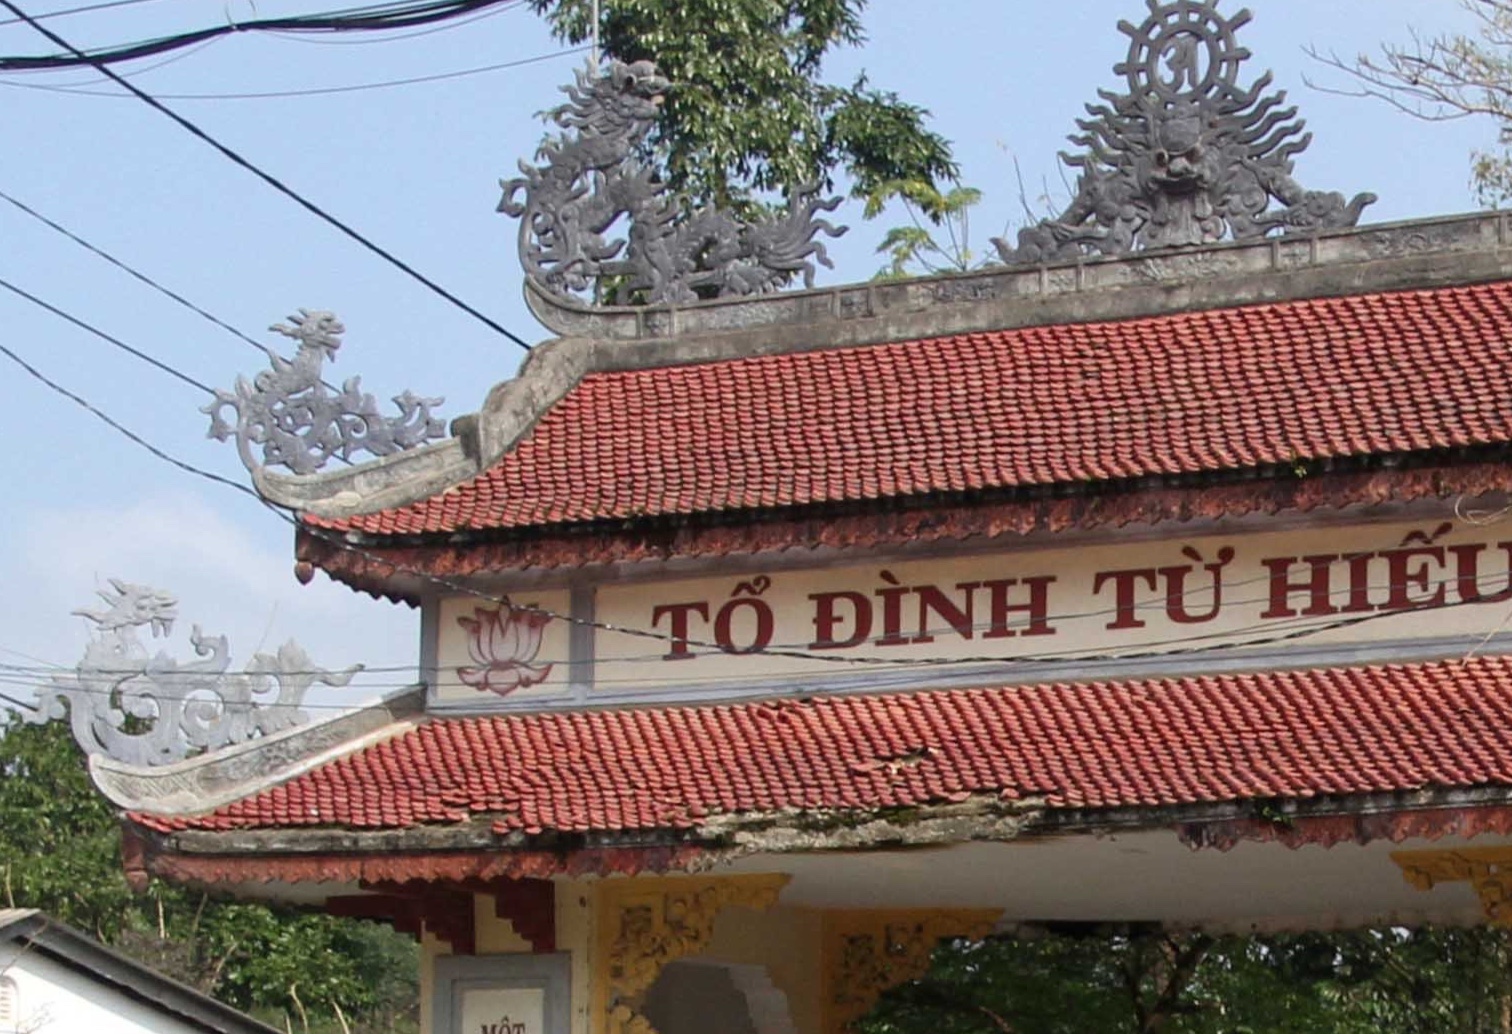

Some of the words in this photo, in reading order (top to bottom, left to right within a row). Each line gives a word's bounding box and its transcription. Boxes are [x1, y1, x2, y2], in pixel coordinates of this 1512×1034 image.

[652, 576, 775, 661] TỔ
[807, 570, 1057, 651] ĐÌNH
[1093, 546, 1235, 630] TỪ
